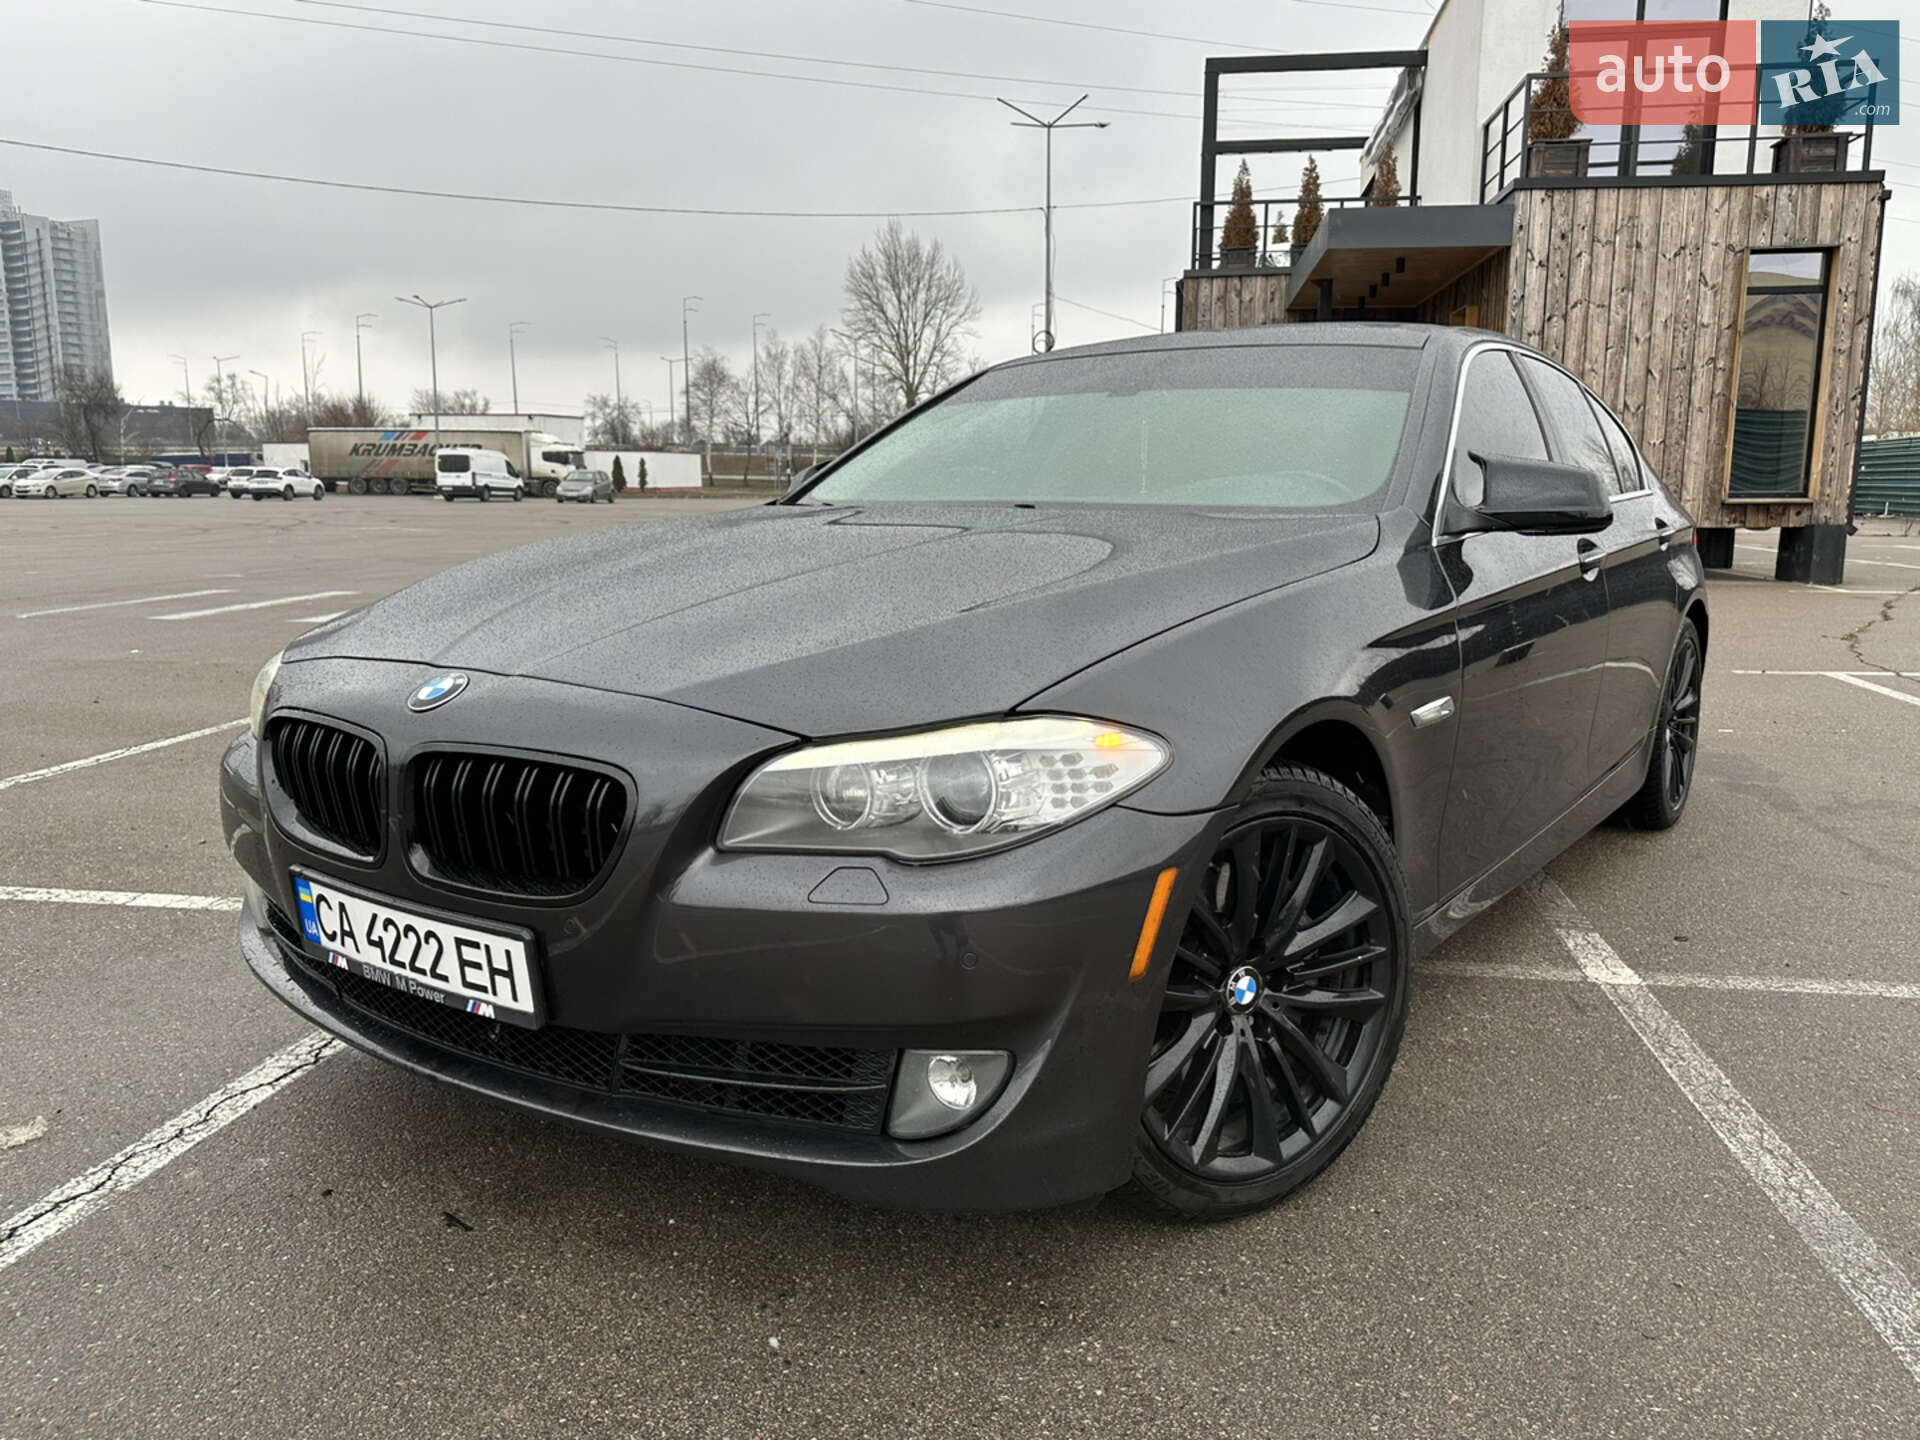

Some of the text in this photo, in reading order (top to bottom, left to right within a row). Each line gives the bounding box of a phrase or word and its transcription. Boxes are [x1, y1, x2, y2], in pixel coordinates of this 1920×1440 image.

[304, 918, 319, 937] UA
[316, 893, 518, 1002] CA 4222 EH
[362, 964, 446, 1005] BMW M Power
